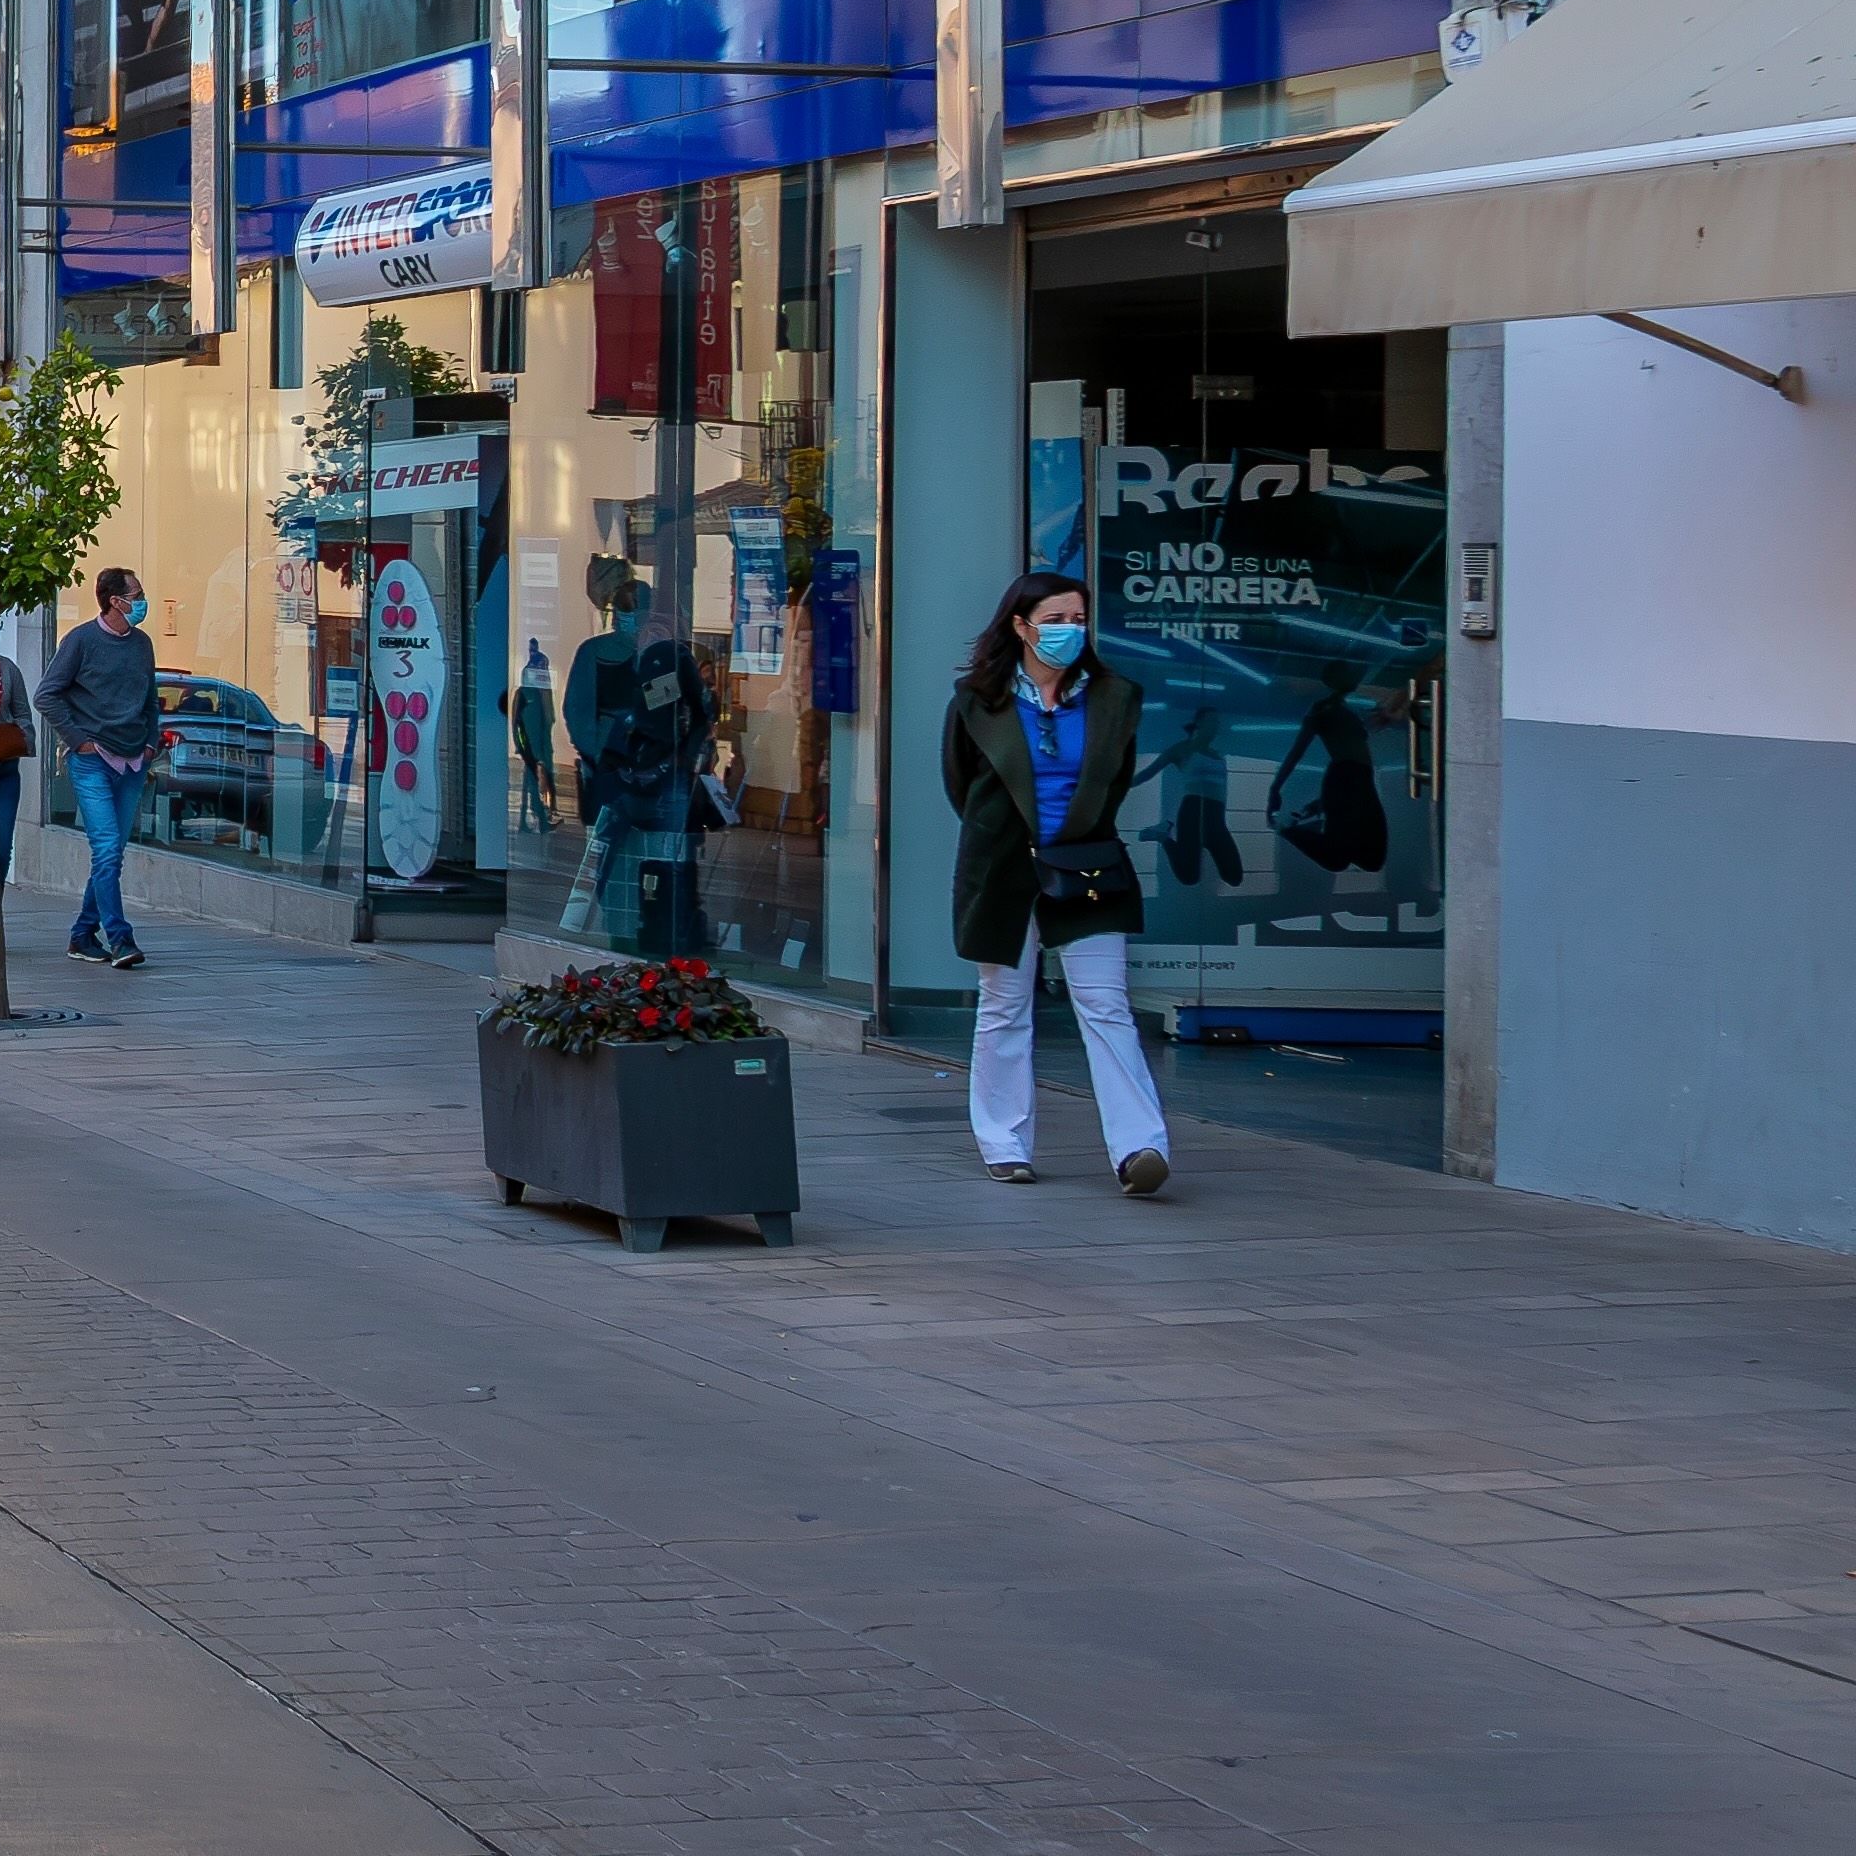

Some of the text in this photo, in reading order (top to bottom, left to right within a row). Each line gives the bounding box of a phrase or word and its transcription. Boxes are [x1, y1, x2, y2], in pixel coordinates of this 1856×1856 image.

[379, 253, 438, 288] CARY
[1125, 542, 1313, 573] SI NO ES UNA
[1210, 622, 1241, 641] TR
[393, 649, 415, 679] 3
[1147, 960, 1183, 971] HEART
[1201, 962, 1236, 972] SPORT
